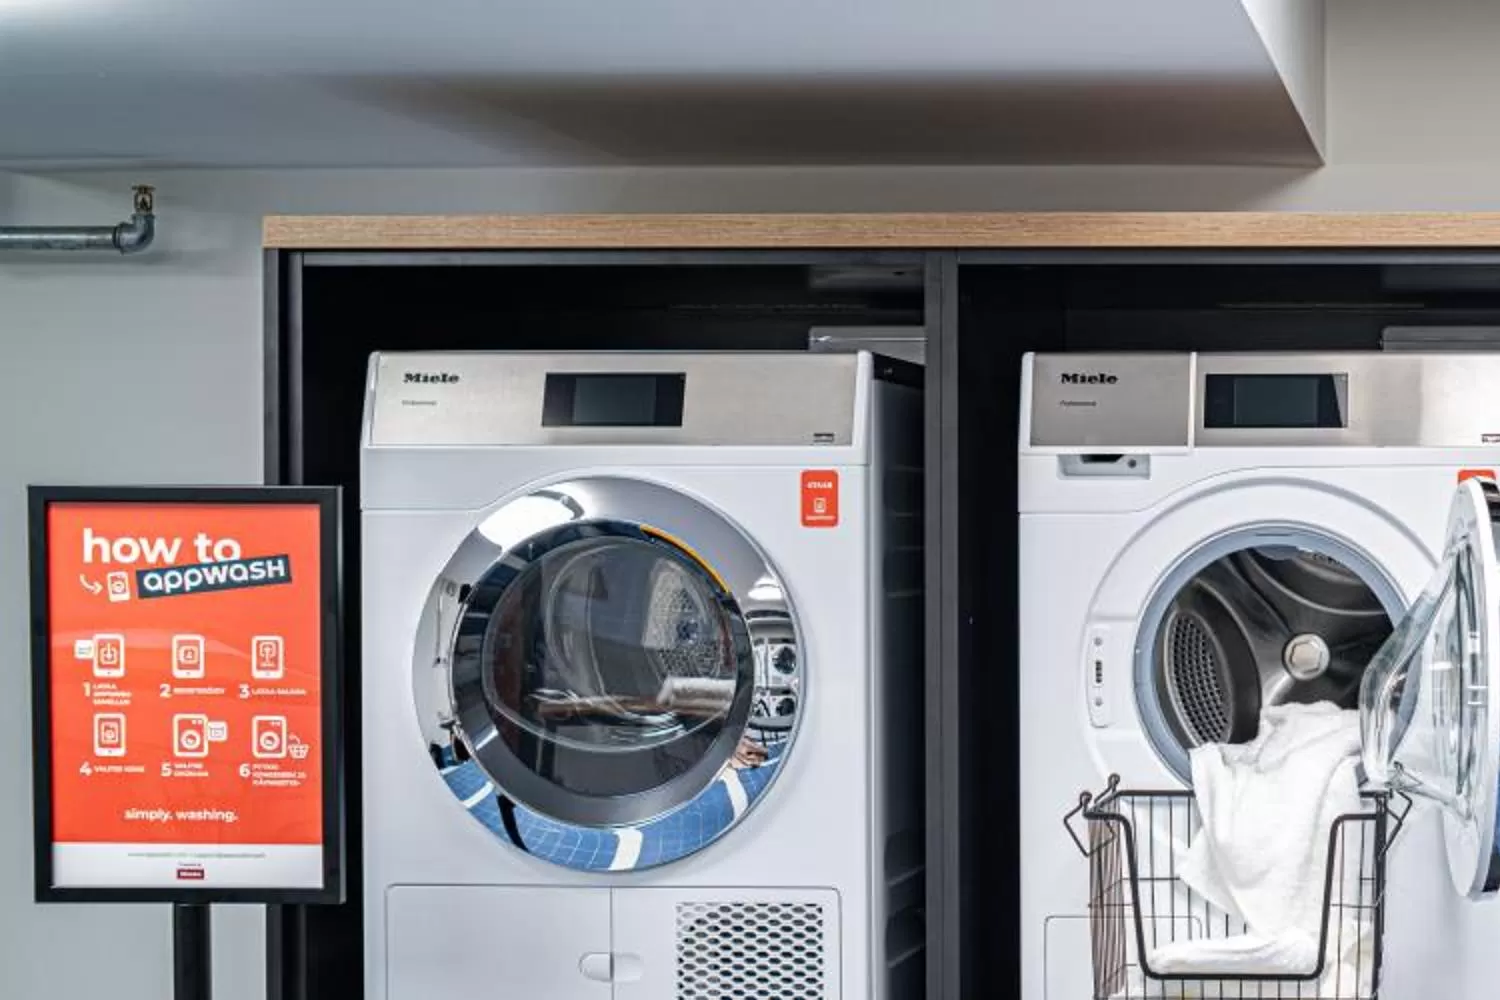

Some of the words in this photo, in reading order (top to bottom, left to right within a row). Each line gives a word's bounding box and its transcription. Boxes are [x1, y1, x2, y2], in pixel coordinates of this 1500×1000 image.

[403, 373, 460, 384] Miele
[1061, 373, 1119, 384] Miele
[83, 528, 182, 564] how
[194, 533, 241, 563] to
[83, 682, 91, 697] 1
[160, 683, 172, 698] 2
[239, 684, 250, 699] 3
[80, 761, 92, 776] 4
[161, 762, 171, 777] 5
[239, 763, 251, 778] 6
[124, 808, 173, 823] simply.
[176, 807, 238, 822] washing.
